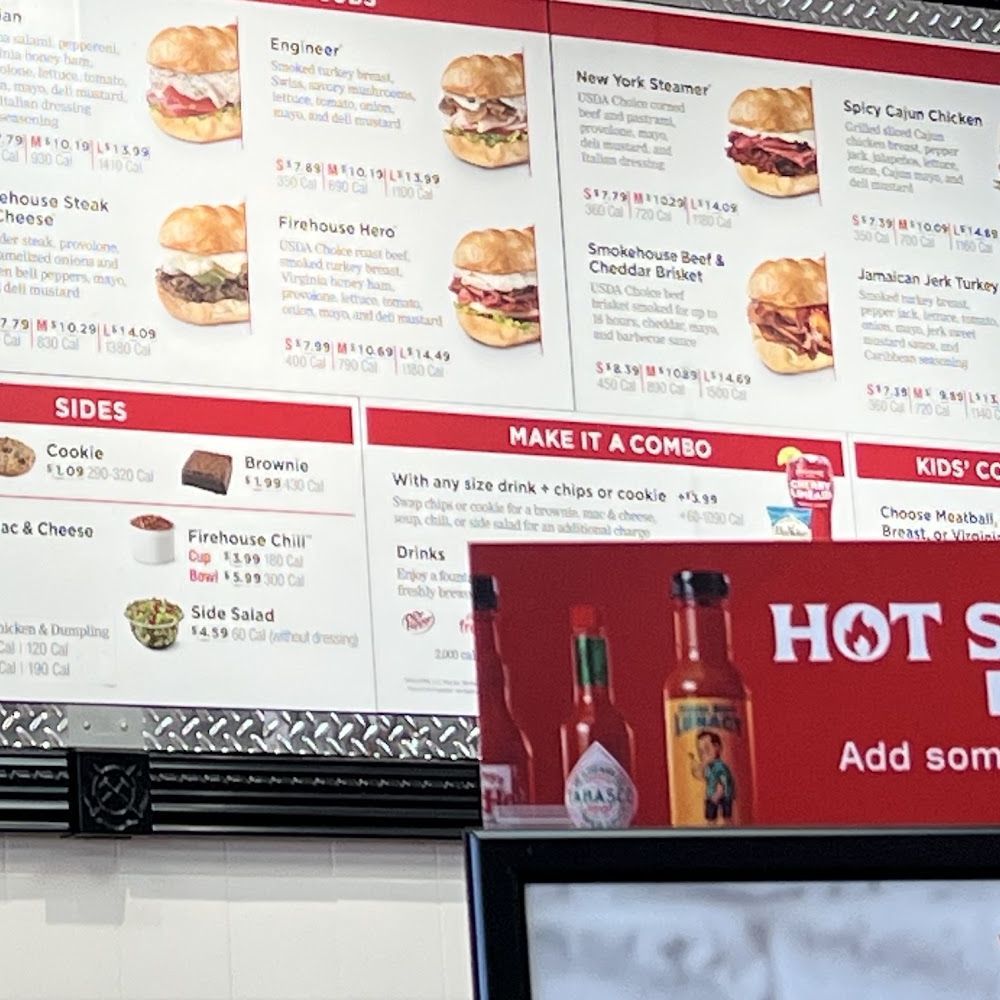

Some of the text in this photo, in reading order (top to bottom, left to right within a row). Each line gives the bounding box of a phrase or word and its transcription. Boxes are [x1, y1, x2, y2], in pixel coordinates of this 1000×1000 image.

[576, 70, 608, 86] New
[613, 74, 644, 89] York
[843, 100, 982, 126] Spicy Cajun Chicken
[64, 194, 108, 211] Steak
[279, 215, 354, 234] Firehouse
[588, 242, 677, 262] Smokehouse
[681, 250, 711, 265] Beef
[589, 259, 702, 282] Cheddar Brisket
[858, 268, 998, 294] Jamaican Jerk Turkey
[55, 398, 126, 422] SIDES
[46, 443, 103, 460] Cookie
[510, 426, 711, 459] MAKE IT A COMBO
[245, 457, 308, 472] Brownie
[392, 472, 428, 488] With
[433, 478, 459, 493] any
[464, 476, 492, 492] size
[498, 478, 536, 494] drink
[554, 481, 592, 500] chips
[597, 487, 612, 498] or
[617, 485, 666, 502] cookie
[880, 506, 930, 521] Choose
[22, 520, 32, 535] &
[38, 520, 93, 537] Cheese
[188, 529, 266, 547] Firehouse
[397, 545, 444, 561] Drinks
[191, 606, 274, 622] Side Salad
[768, 599, 941, 664] HOT
[839, 740, 910, 772] Add
